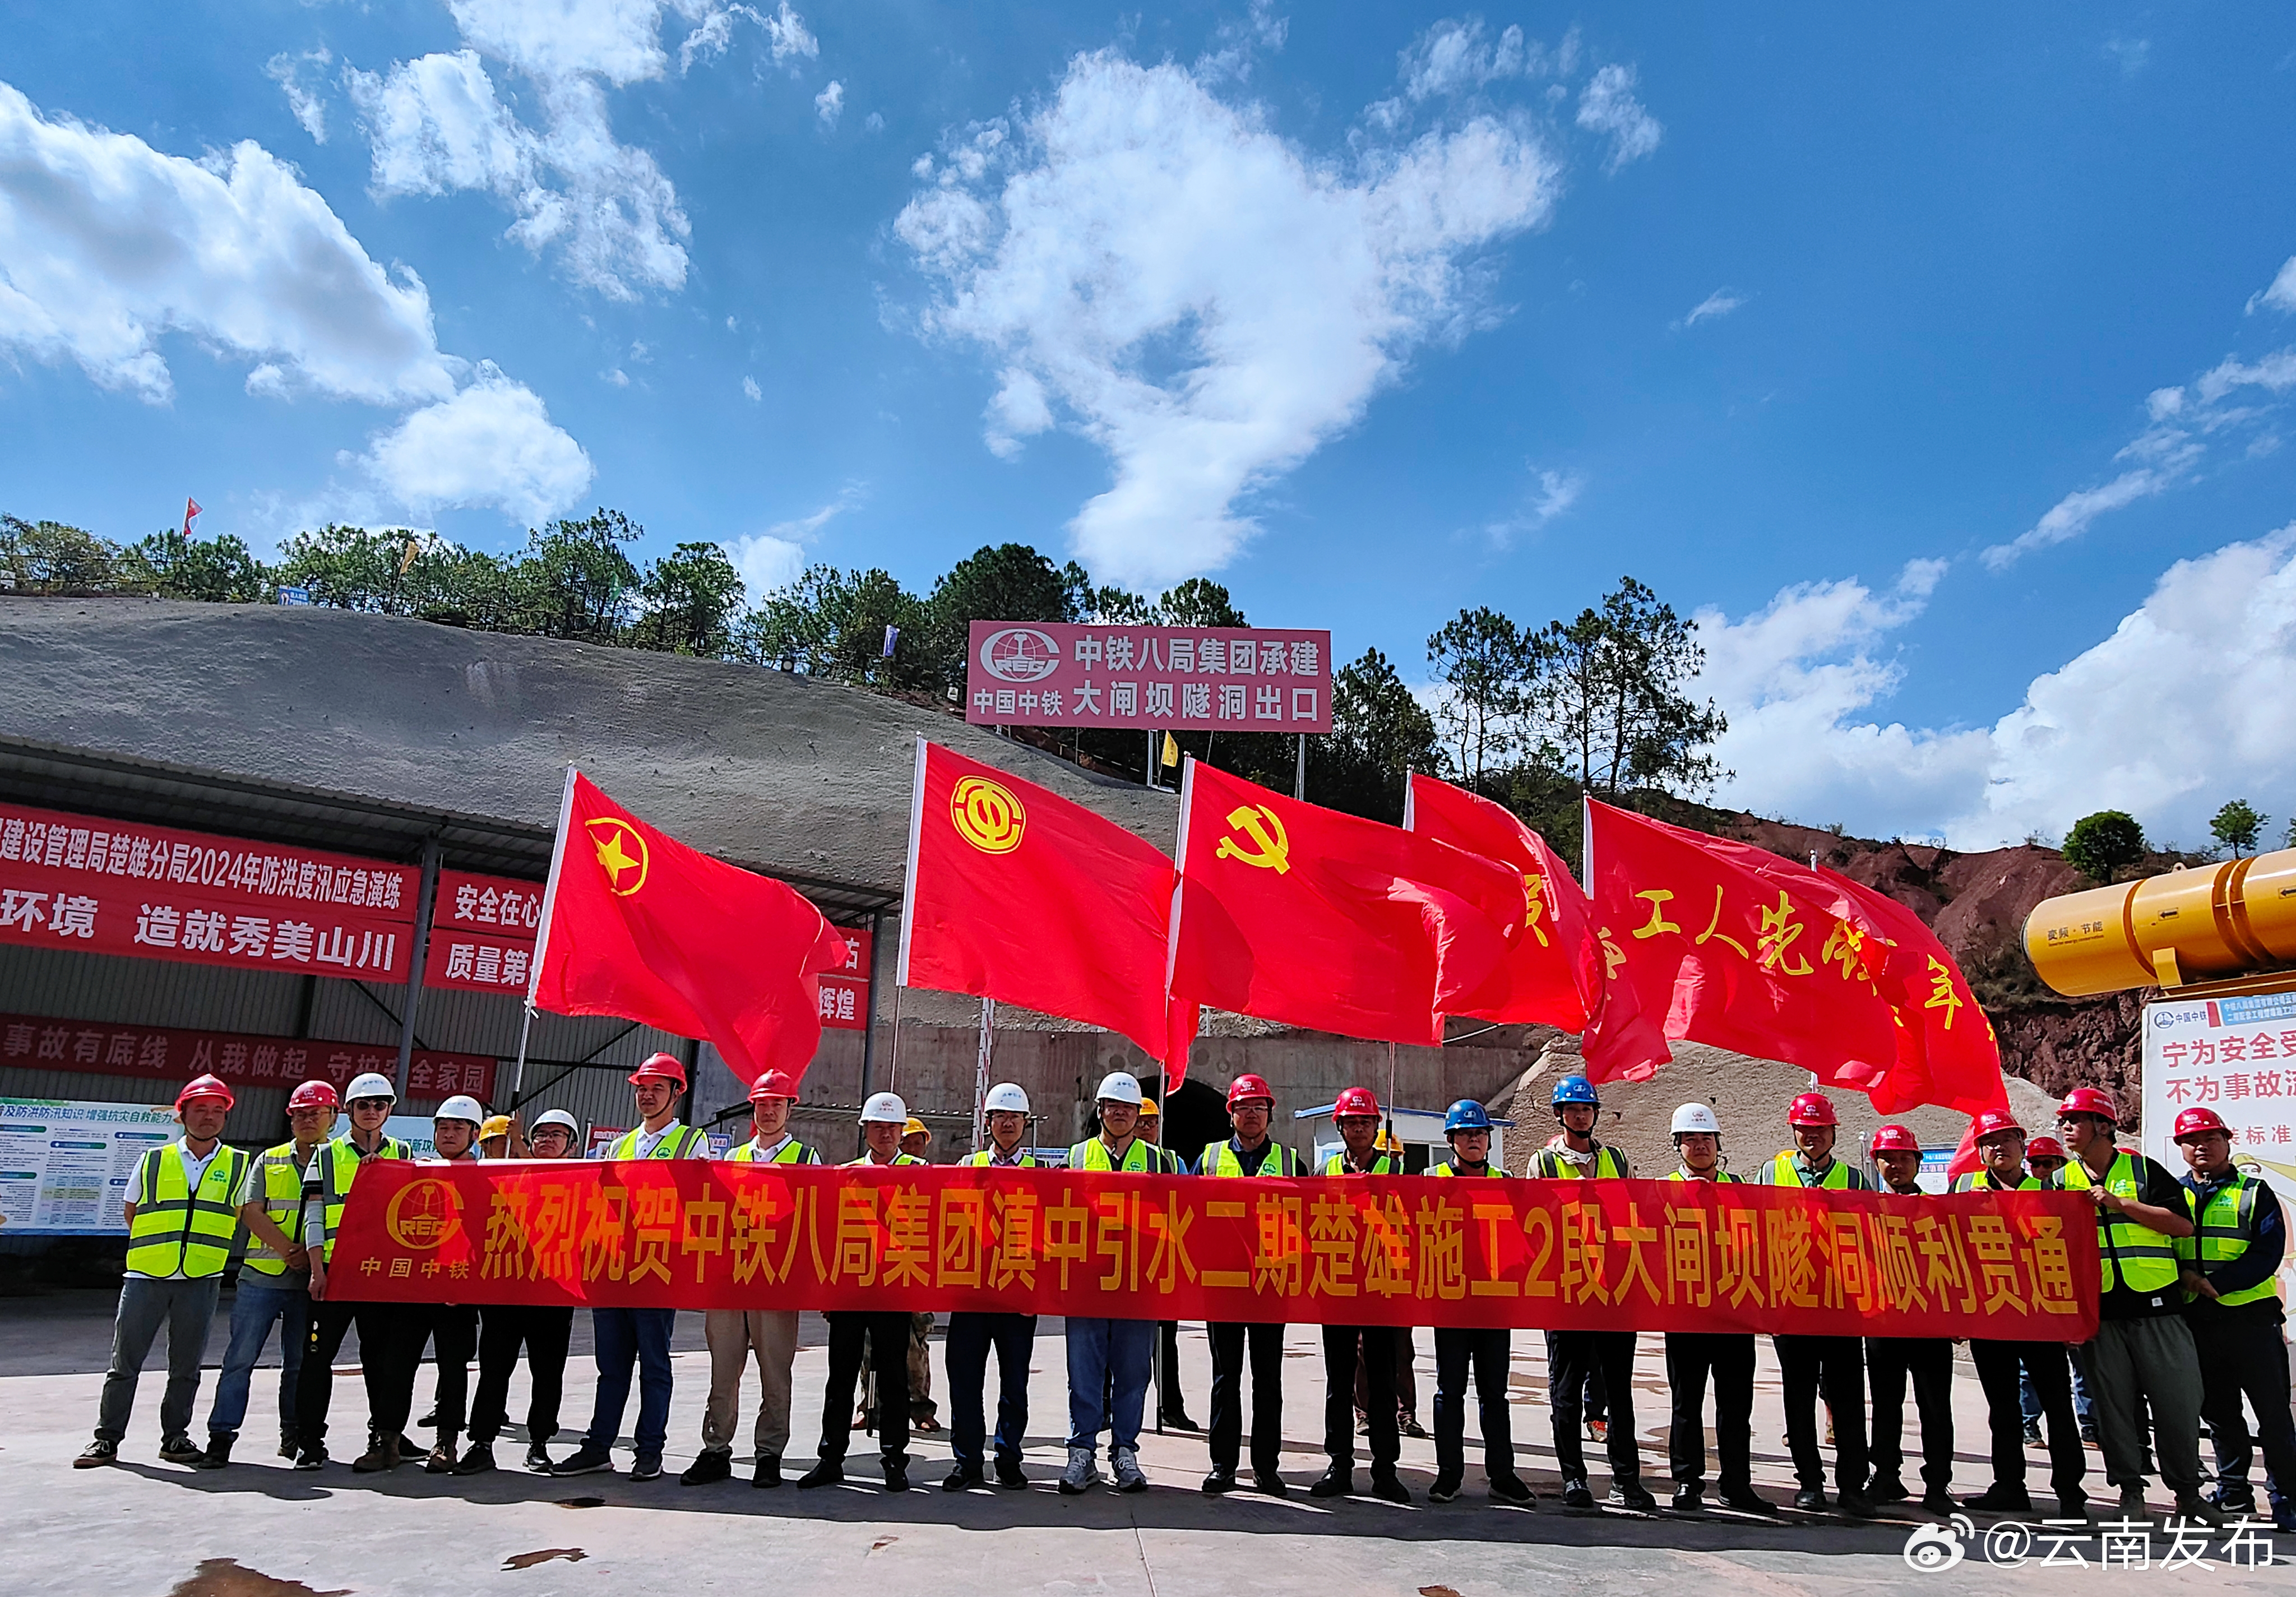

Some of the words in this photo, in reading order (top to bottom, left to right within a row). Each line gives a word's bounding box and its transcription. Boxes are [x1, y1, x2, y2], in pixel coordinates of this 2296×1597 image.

[1075, 634, 1319, 676] 中铁八局集团承建
[973, 688, 1063, 716] 中国中铁
[1072, 679, 1318, 721] 大闸坝隧洞出口
[0, 817, 402, 909] 建设管理局楚雄分局2024年防洪度汛应急演练
[455, 883, 541, 928] 安全在心
[0, 889, 98, 938] 环境
[134, 903, 395, 971] 造就秀美山川
[445, 943, 534, 986] 质量第
[2175, 1011, 2207, 1024] 中国中铁
[3, 1022, 169, 1069] 事故有底线
[188, 1039, 308, 1080] 从我做起
[85, 1109, 172, 1124] 增强抗灾自救能力
[360, 1257, 470, 1280] 中国中铁
[480, 1181, 2078, 1316] 热烈祝贺中铁八局集团滇中引水二期楚雄施工2段大闸坝隧洞顺利贯通
